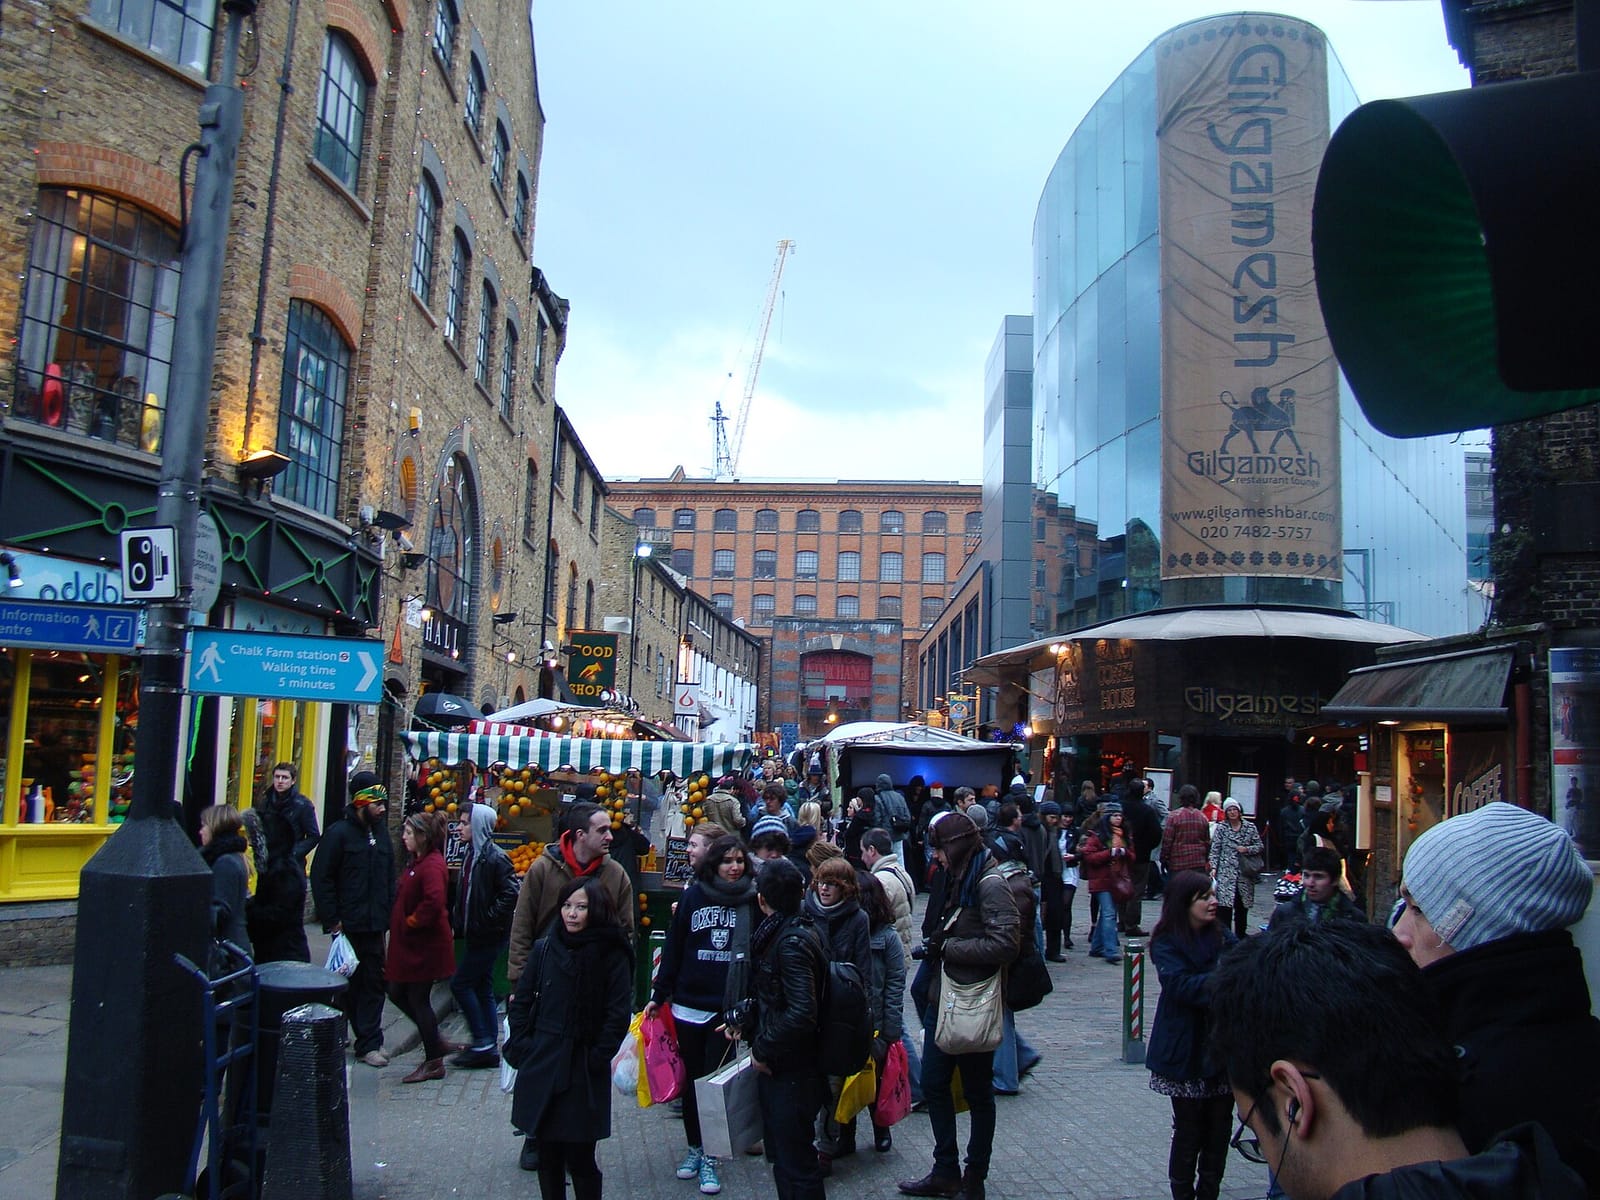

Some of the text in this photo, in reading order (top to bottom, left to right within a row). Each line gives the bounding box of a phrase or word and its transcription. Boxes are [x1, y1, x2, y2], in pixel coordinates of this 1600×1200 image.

[1206, 44, 1296, 368] Gilgamesh
[1187, 450, 1321, 484] Gilgamesh
[1236, 475, 1320, 488] restaurant lounge
[1170, 504, 1336, 524] www.gilgameshbar.com
[1200, 525, 1312, 540] 020 7482-5757
[39, 570, 119, 603] oddb
[2, 608, 80, 625] Information
[0, 624, 33, 636] entre
[425, 616, 458, 653] HALL
[230, 644, 337, 661] Chalk Farm station
[262, 661, 337, 676] Walking time
[278, 677, 336, 690] 5 minutes
[691, 905, 737, 933] OXFOR
